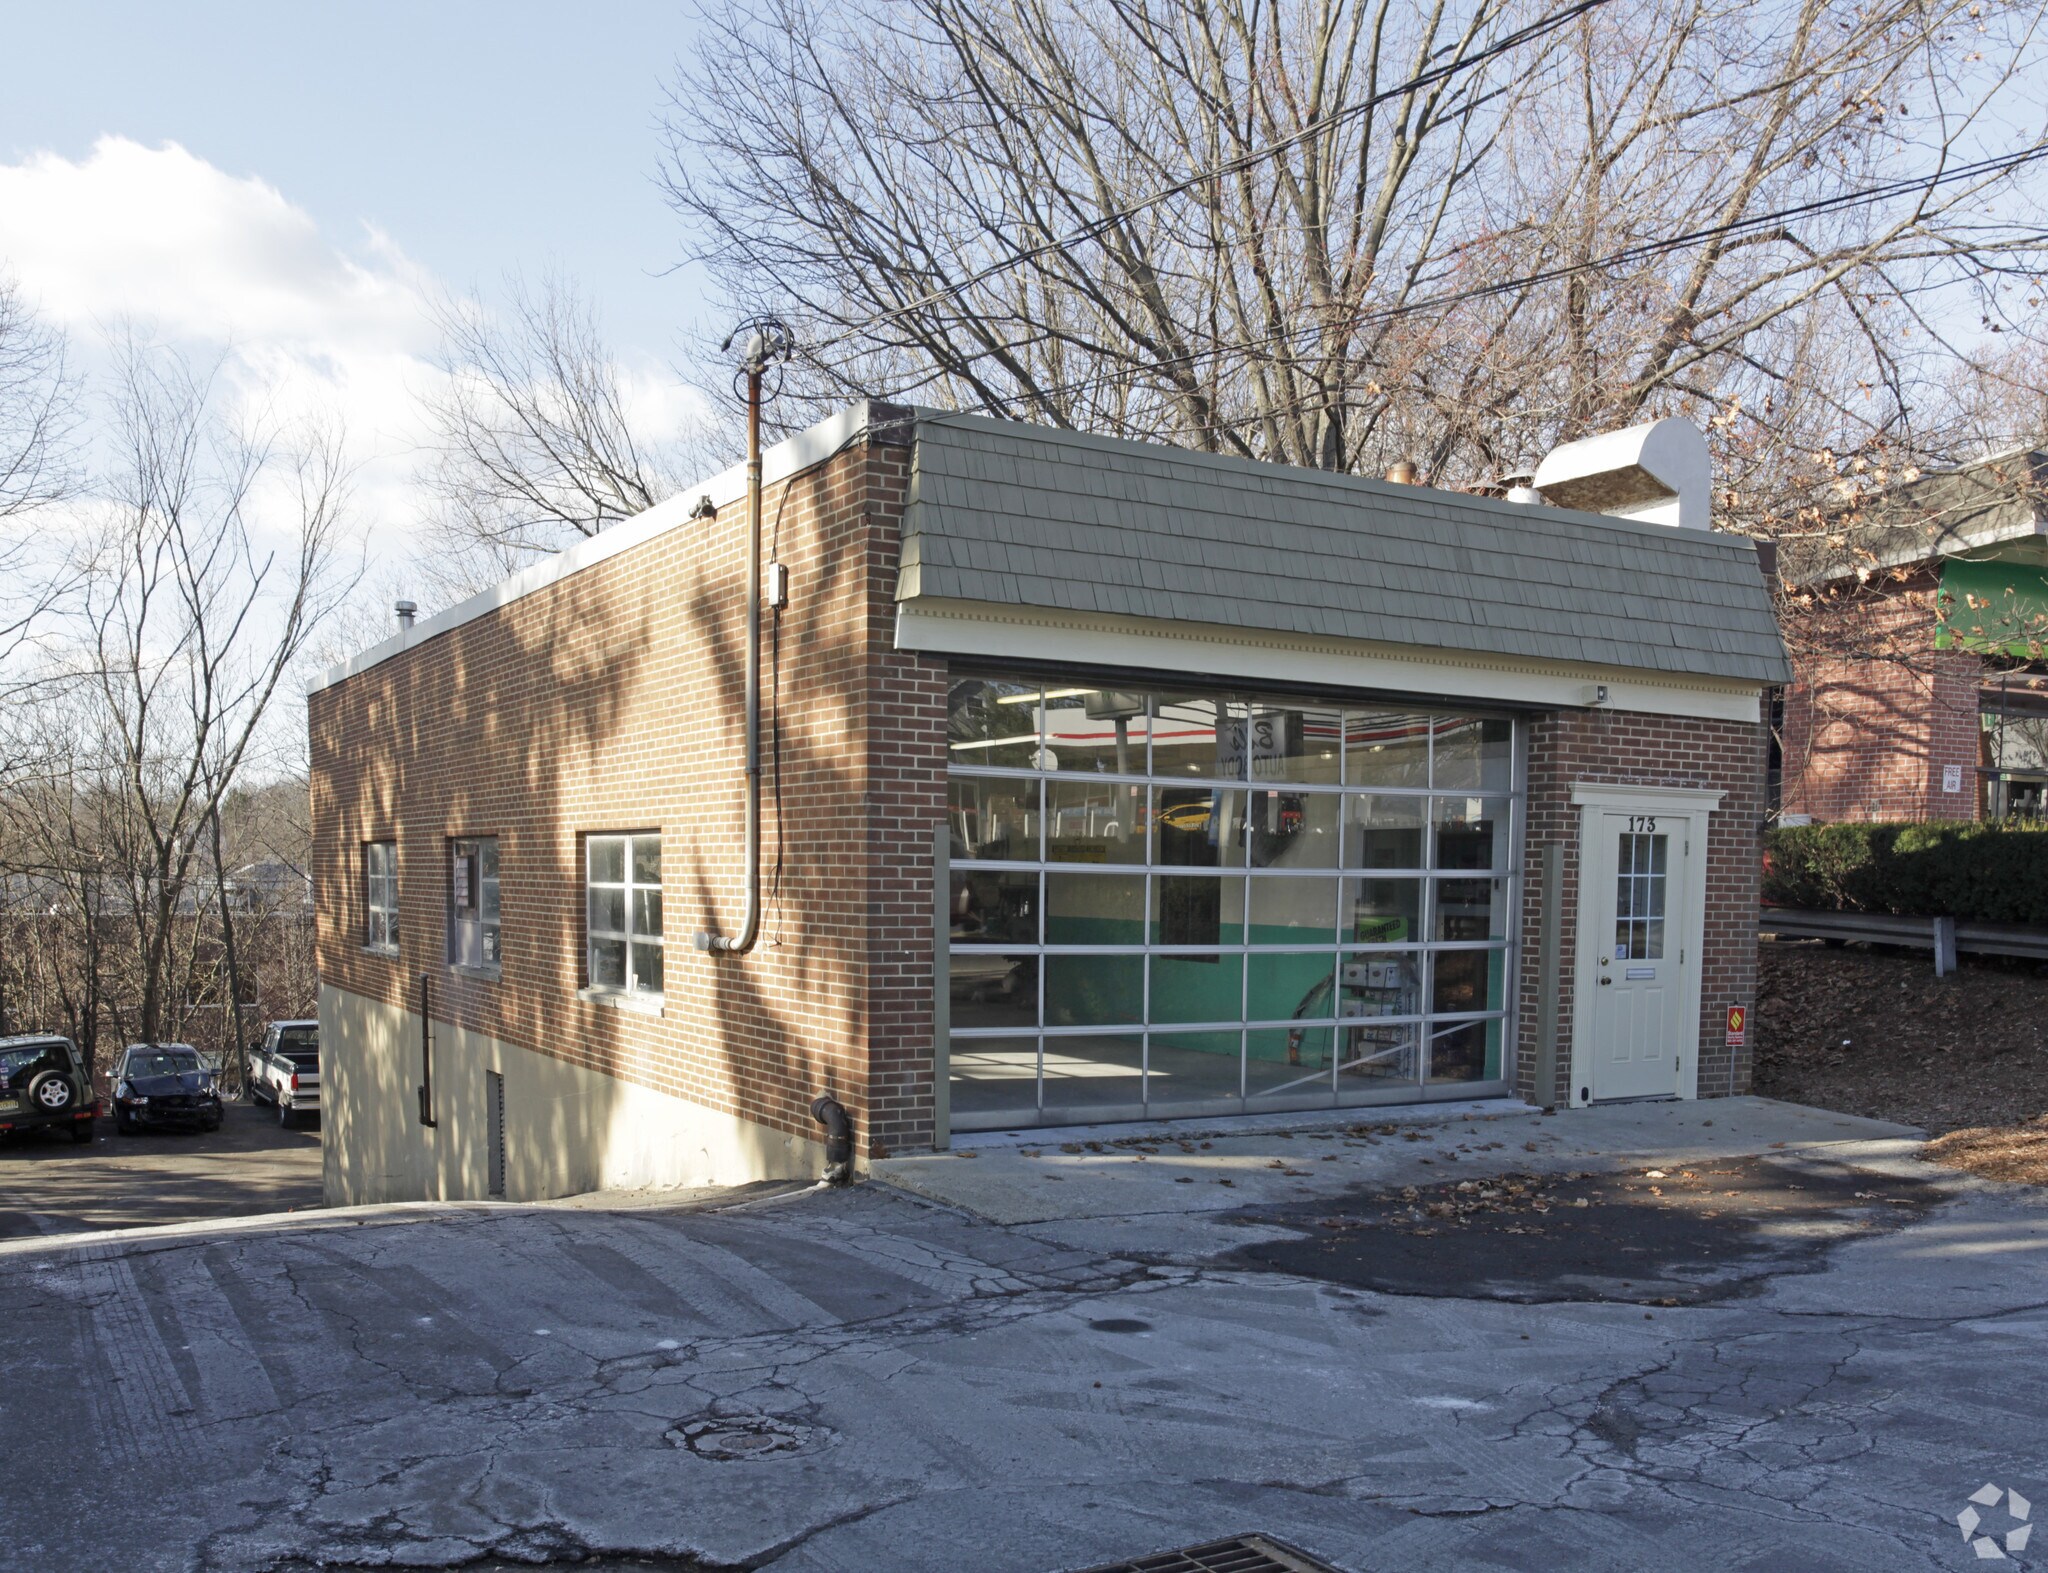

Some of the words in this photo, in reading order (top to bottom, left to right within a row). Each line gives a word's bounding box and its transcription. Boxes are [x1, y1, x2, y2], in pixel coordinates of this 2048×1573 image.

[1944, 766, 1960, 777] FREE
[1946, 780, 1957, 790] AIR
[1628, 816, 1656, 833] 173
